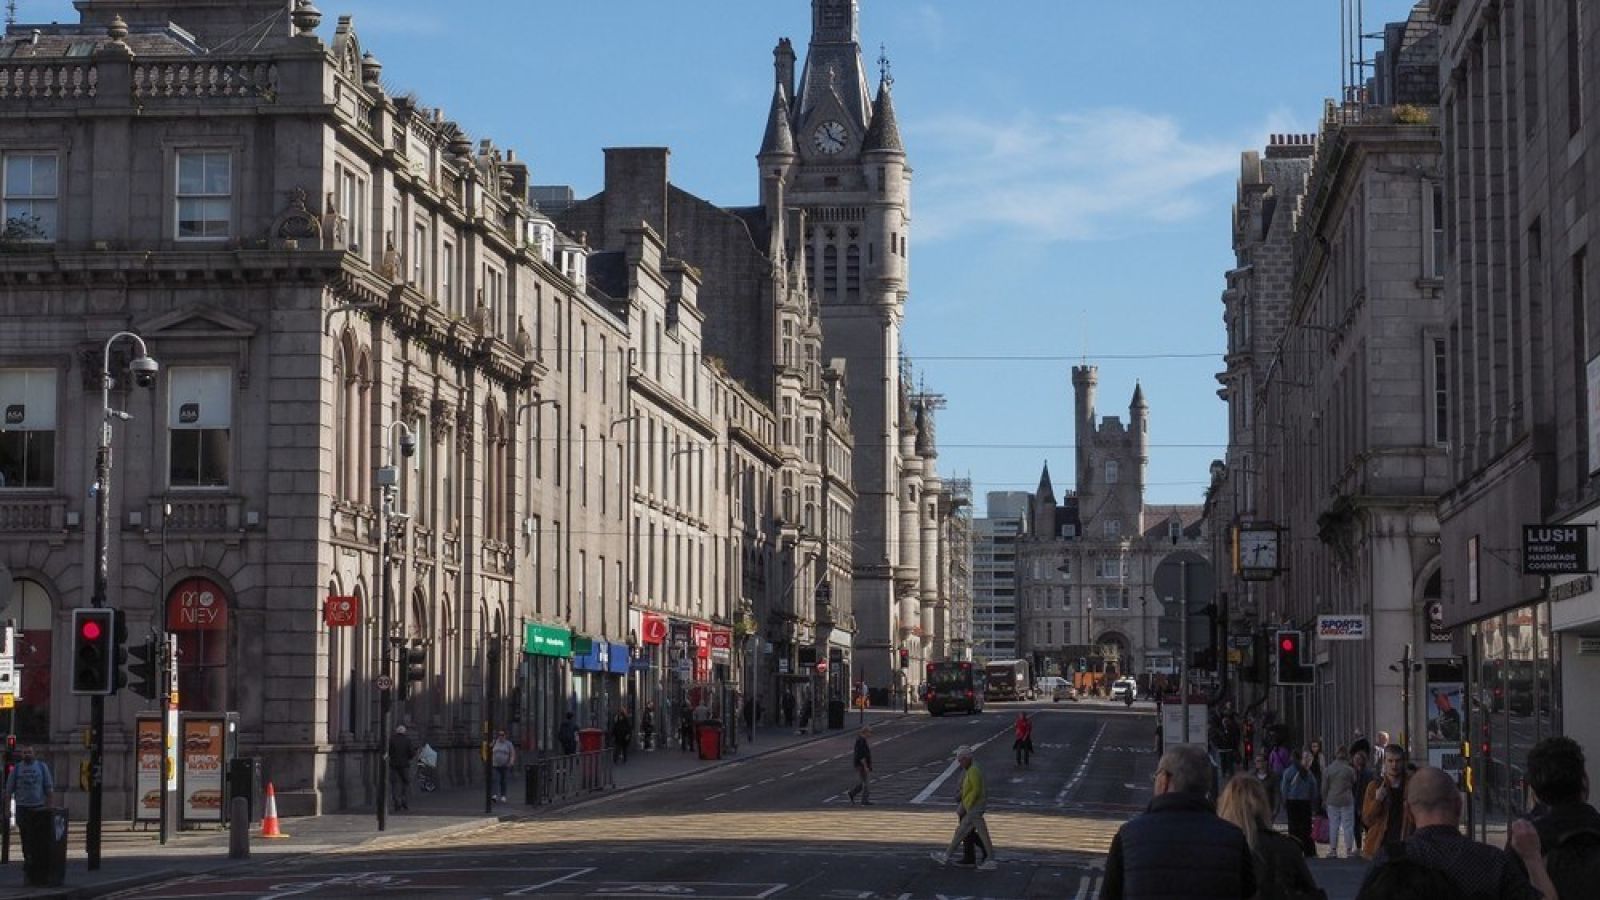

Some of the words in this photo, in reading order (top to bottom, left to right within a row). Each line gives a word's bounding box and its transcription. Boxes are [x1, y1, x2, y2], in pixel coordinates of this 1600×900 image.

[1527, 528, 1577, 542] LUSH
[1527, 545, 1556, 553] FRESH
[1527, 553, 1577, 561] HANDMADE
[1321, 620, 1363, 629] SPORTS
[378, 679, 390, 687] 20
